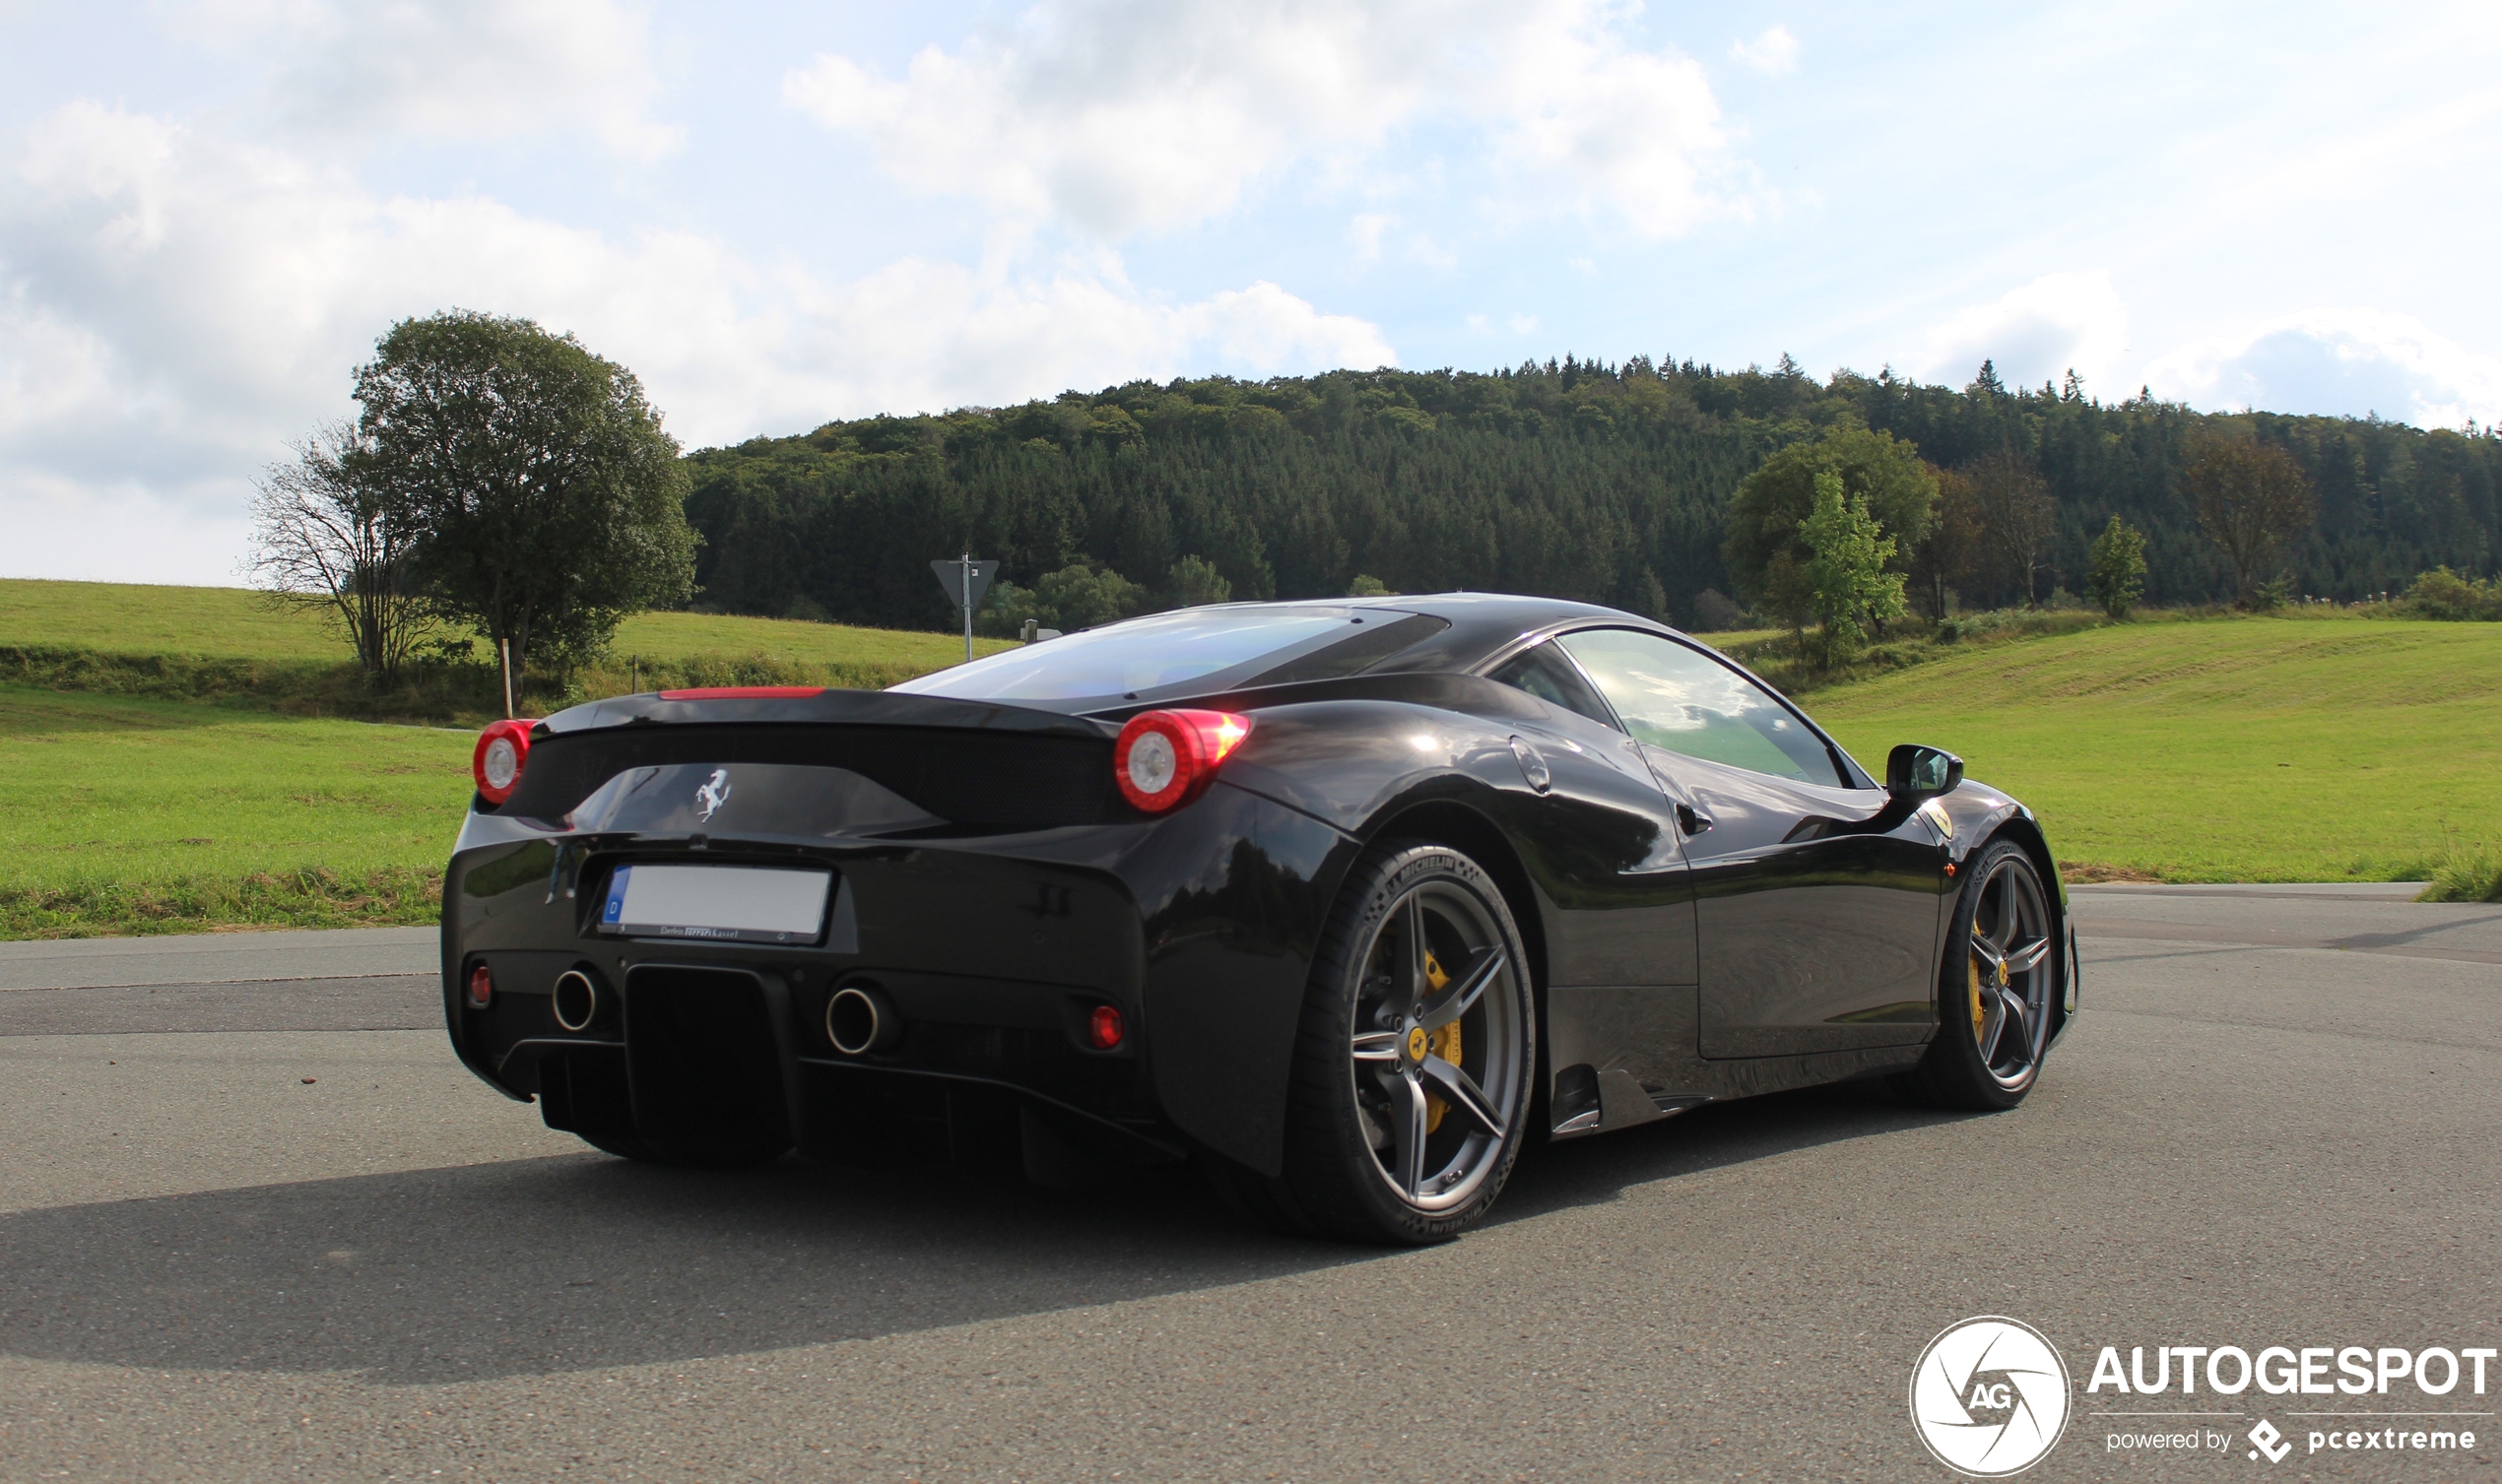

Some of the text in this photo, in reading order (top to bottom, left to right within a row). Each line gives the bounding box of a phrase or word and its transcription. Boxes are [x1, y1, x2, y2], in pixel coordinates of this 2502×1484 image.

[1401, 856, 1455, 881] MICHELIN
[610, 901, 618, 915] D
[712, 929, 739, 938] Kassel
[1429, 1201, 1483, 1235] MICHELIN
